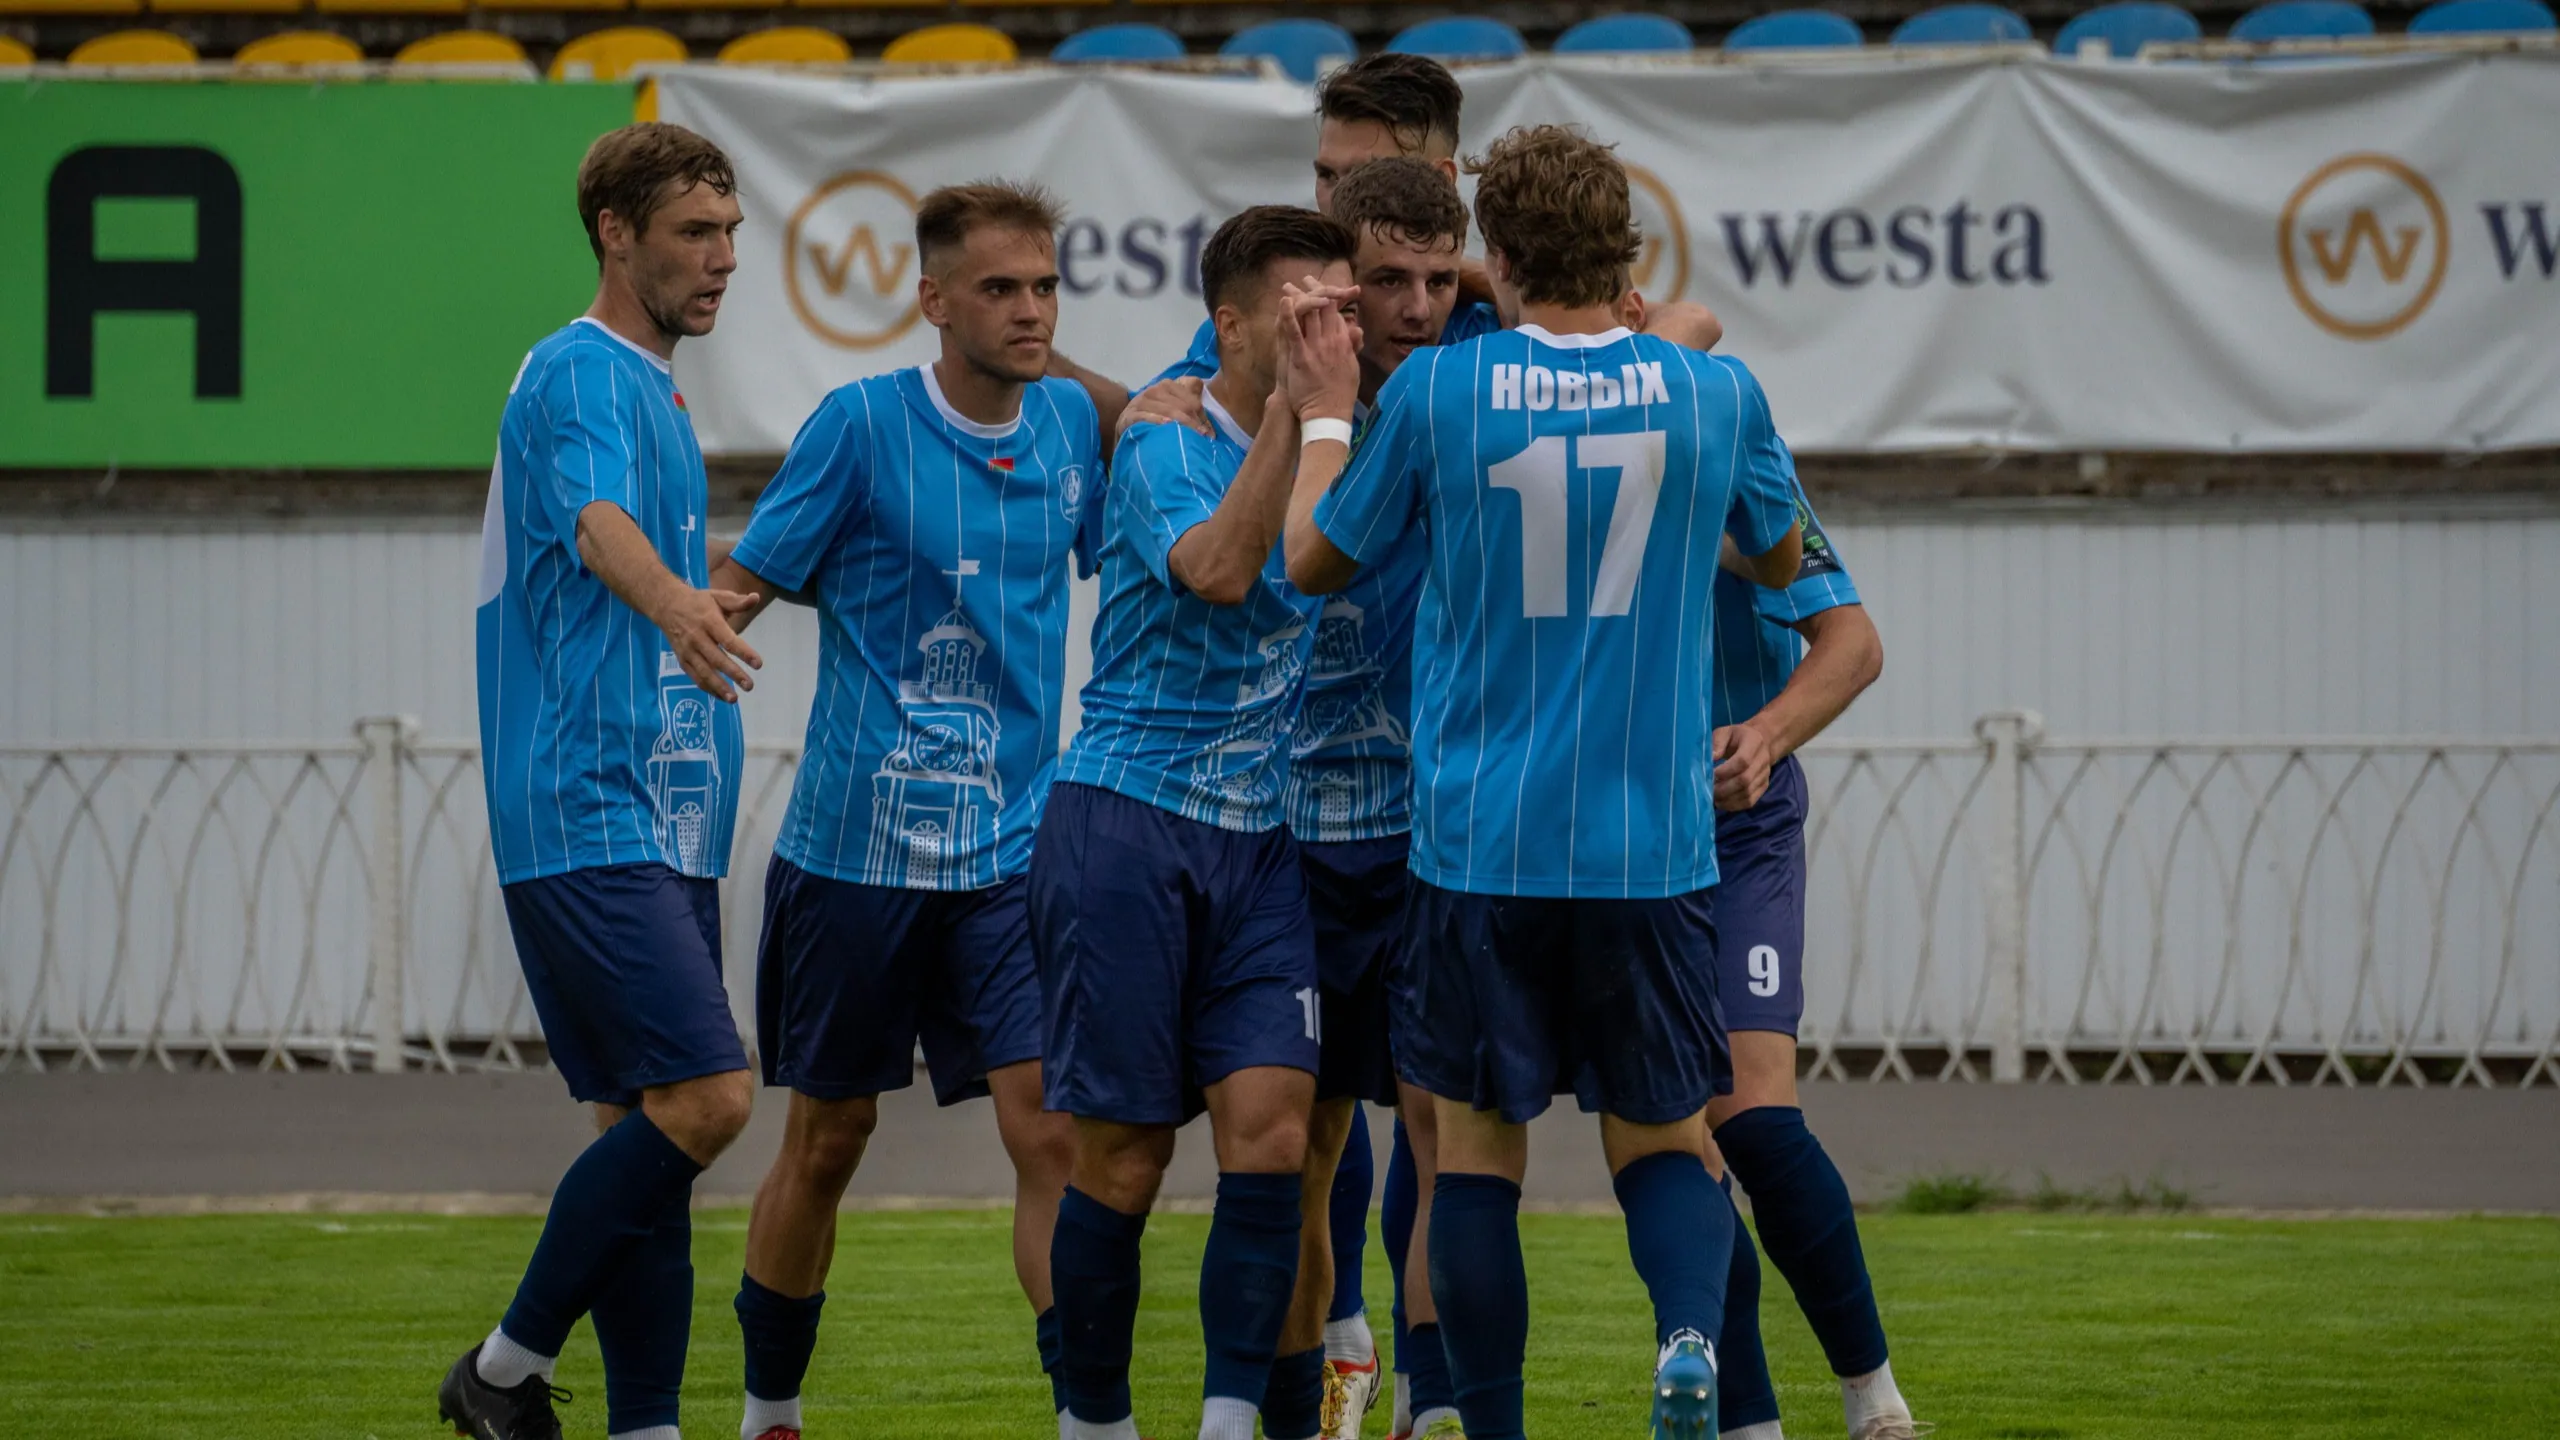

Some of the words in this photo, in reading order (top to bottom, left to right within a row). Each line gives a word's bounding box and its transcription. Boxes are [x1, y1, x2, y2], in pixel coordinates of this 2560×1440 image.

[1057, 213, 1210, 300] est
[1718, 199, 2052, 290] westa
[1491, 361, 1670, 412] НОВЫХ
[1488, 430, 1666, 617] 17
[1747, 944, 1780, 998] 9
